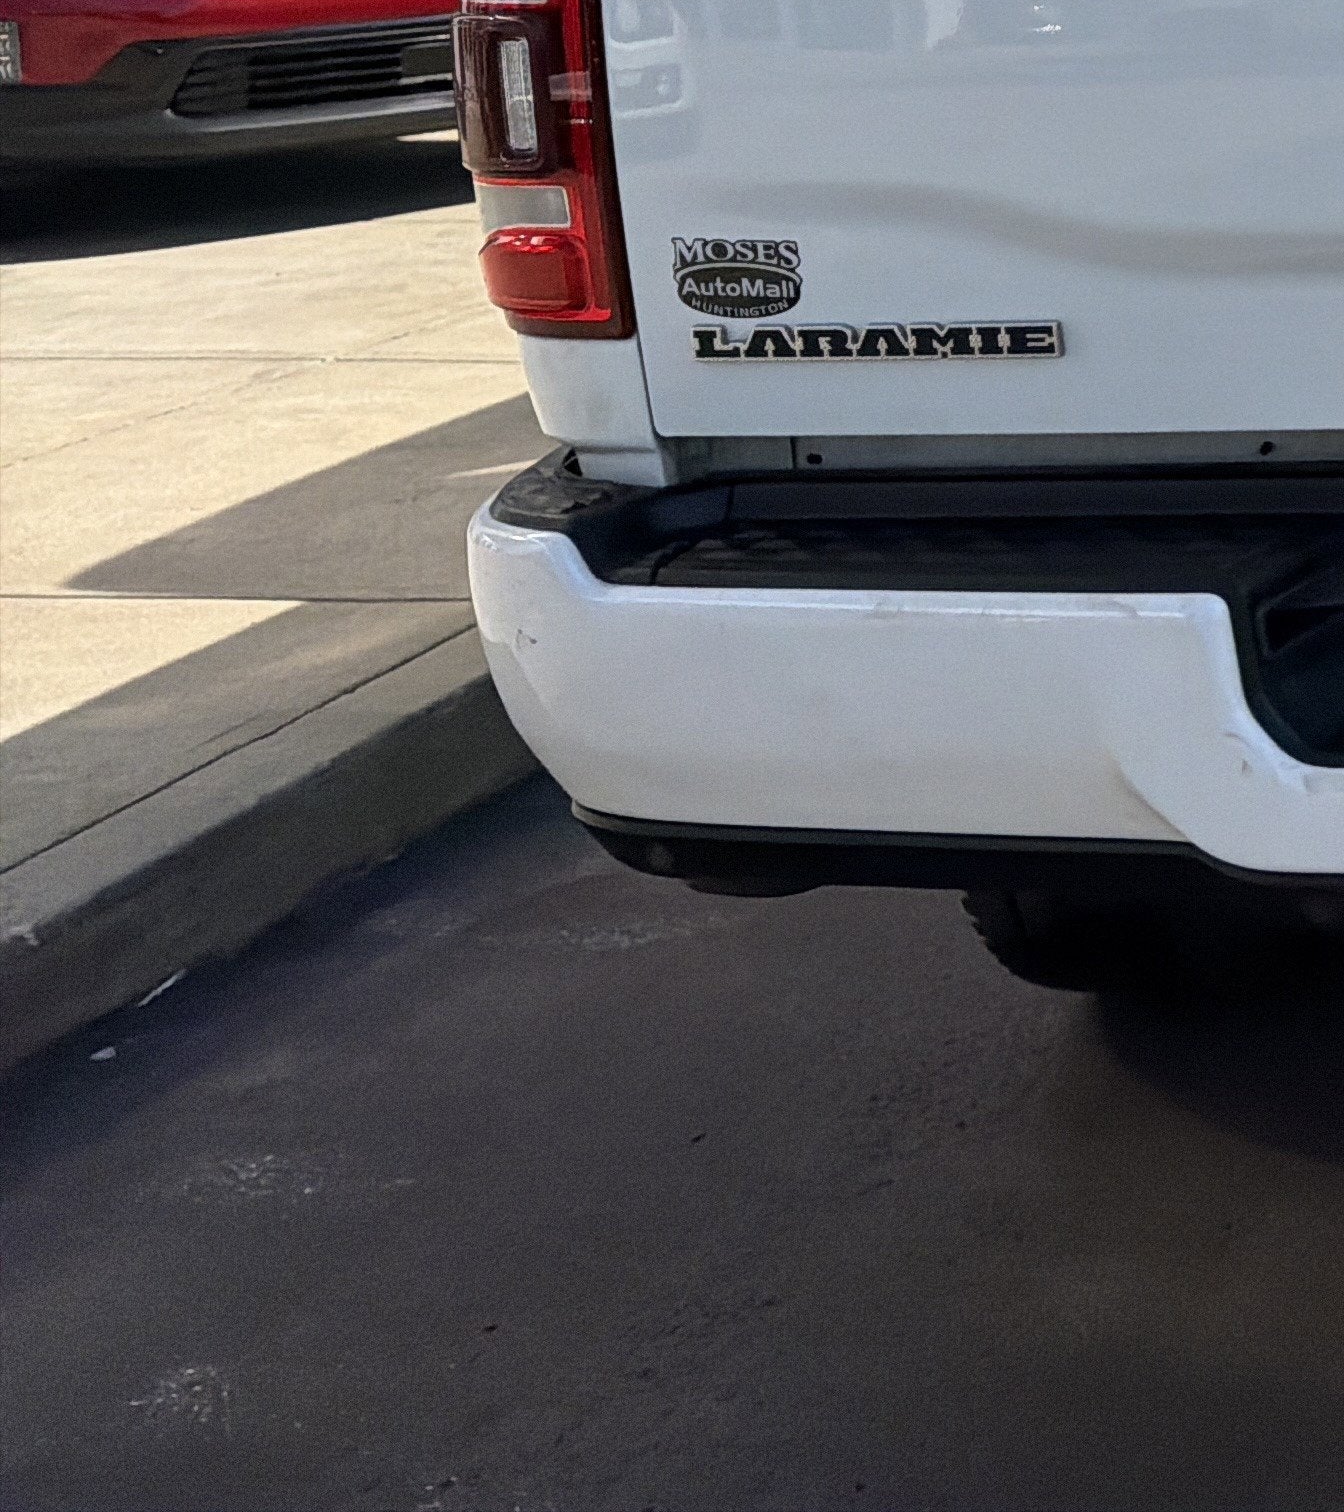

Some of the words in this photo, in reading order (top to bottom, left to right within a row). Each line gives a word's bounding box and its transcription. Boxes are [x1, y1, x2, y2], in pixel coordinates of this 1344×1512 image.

[672, 238, 800, 270] MOSES
[681, 276, 796, 299] AutoMall
[691, 297, 789, 317] HUNTINGTON
[691, 320, 1061, 361] LARAMIE
